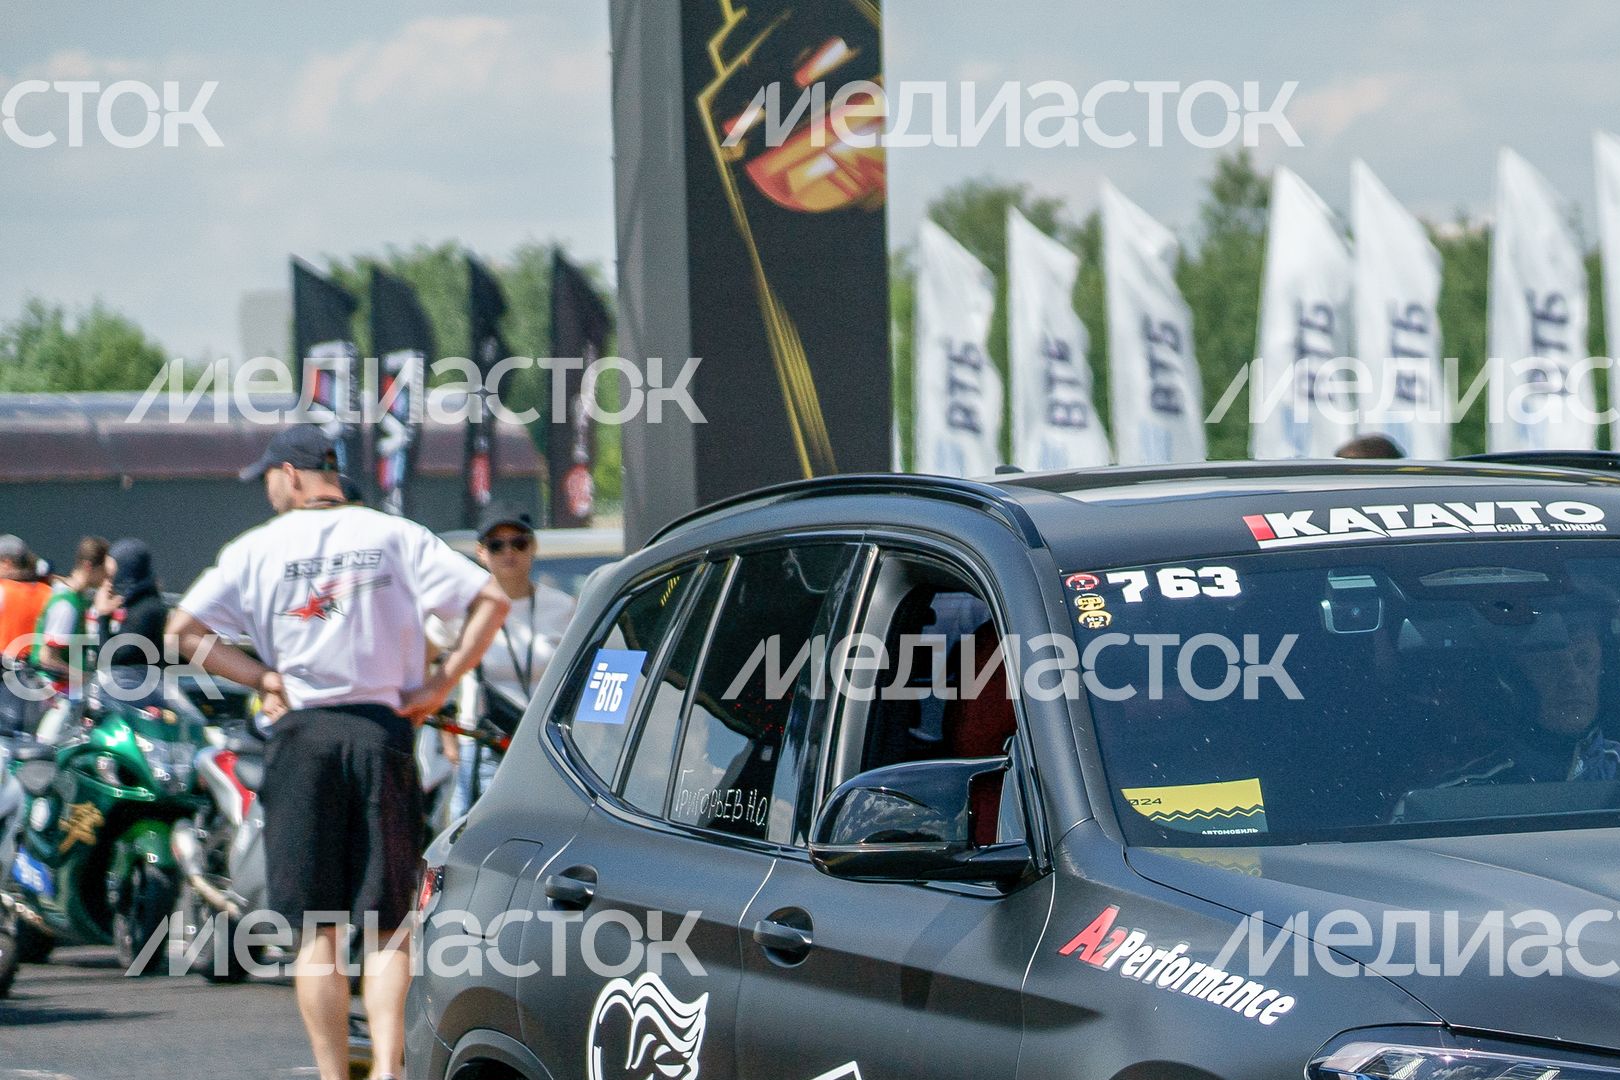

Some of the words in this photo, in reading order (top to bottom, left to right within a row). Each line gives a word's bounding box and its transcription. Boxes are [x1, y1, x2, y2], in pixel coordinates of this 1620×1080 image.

[1496, 522, 1533, 534] CHIP
[1551, 522, 1607, 532] TUNING
[1106, 565, 1241, 603] 763
[593, 672, 629, 713] ВТБ
